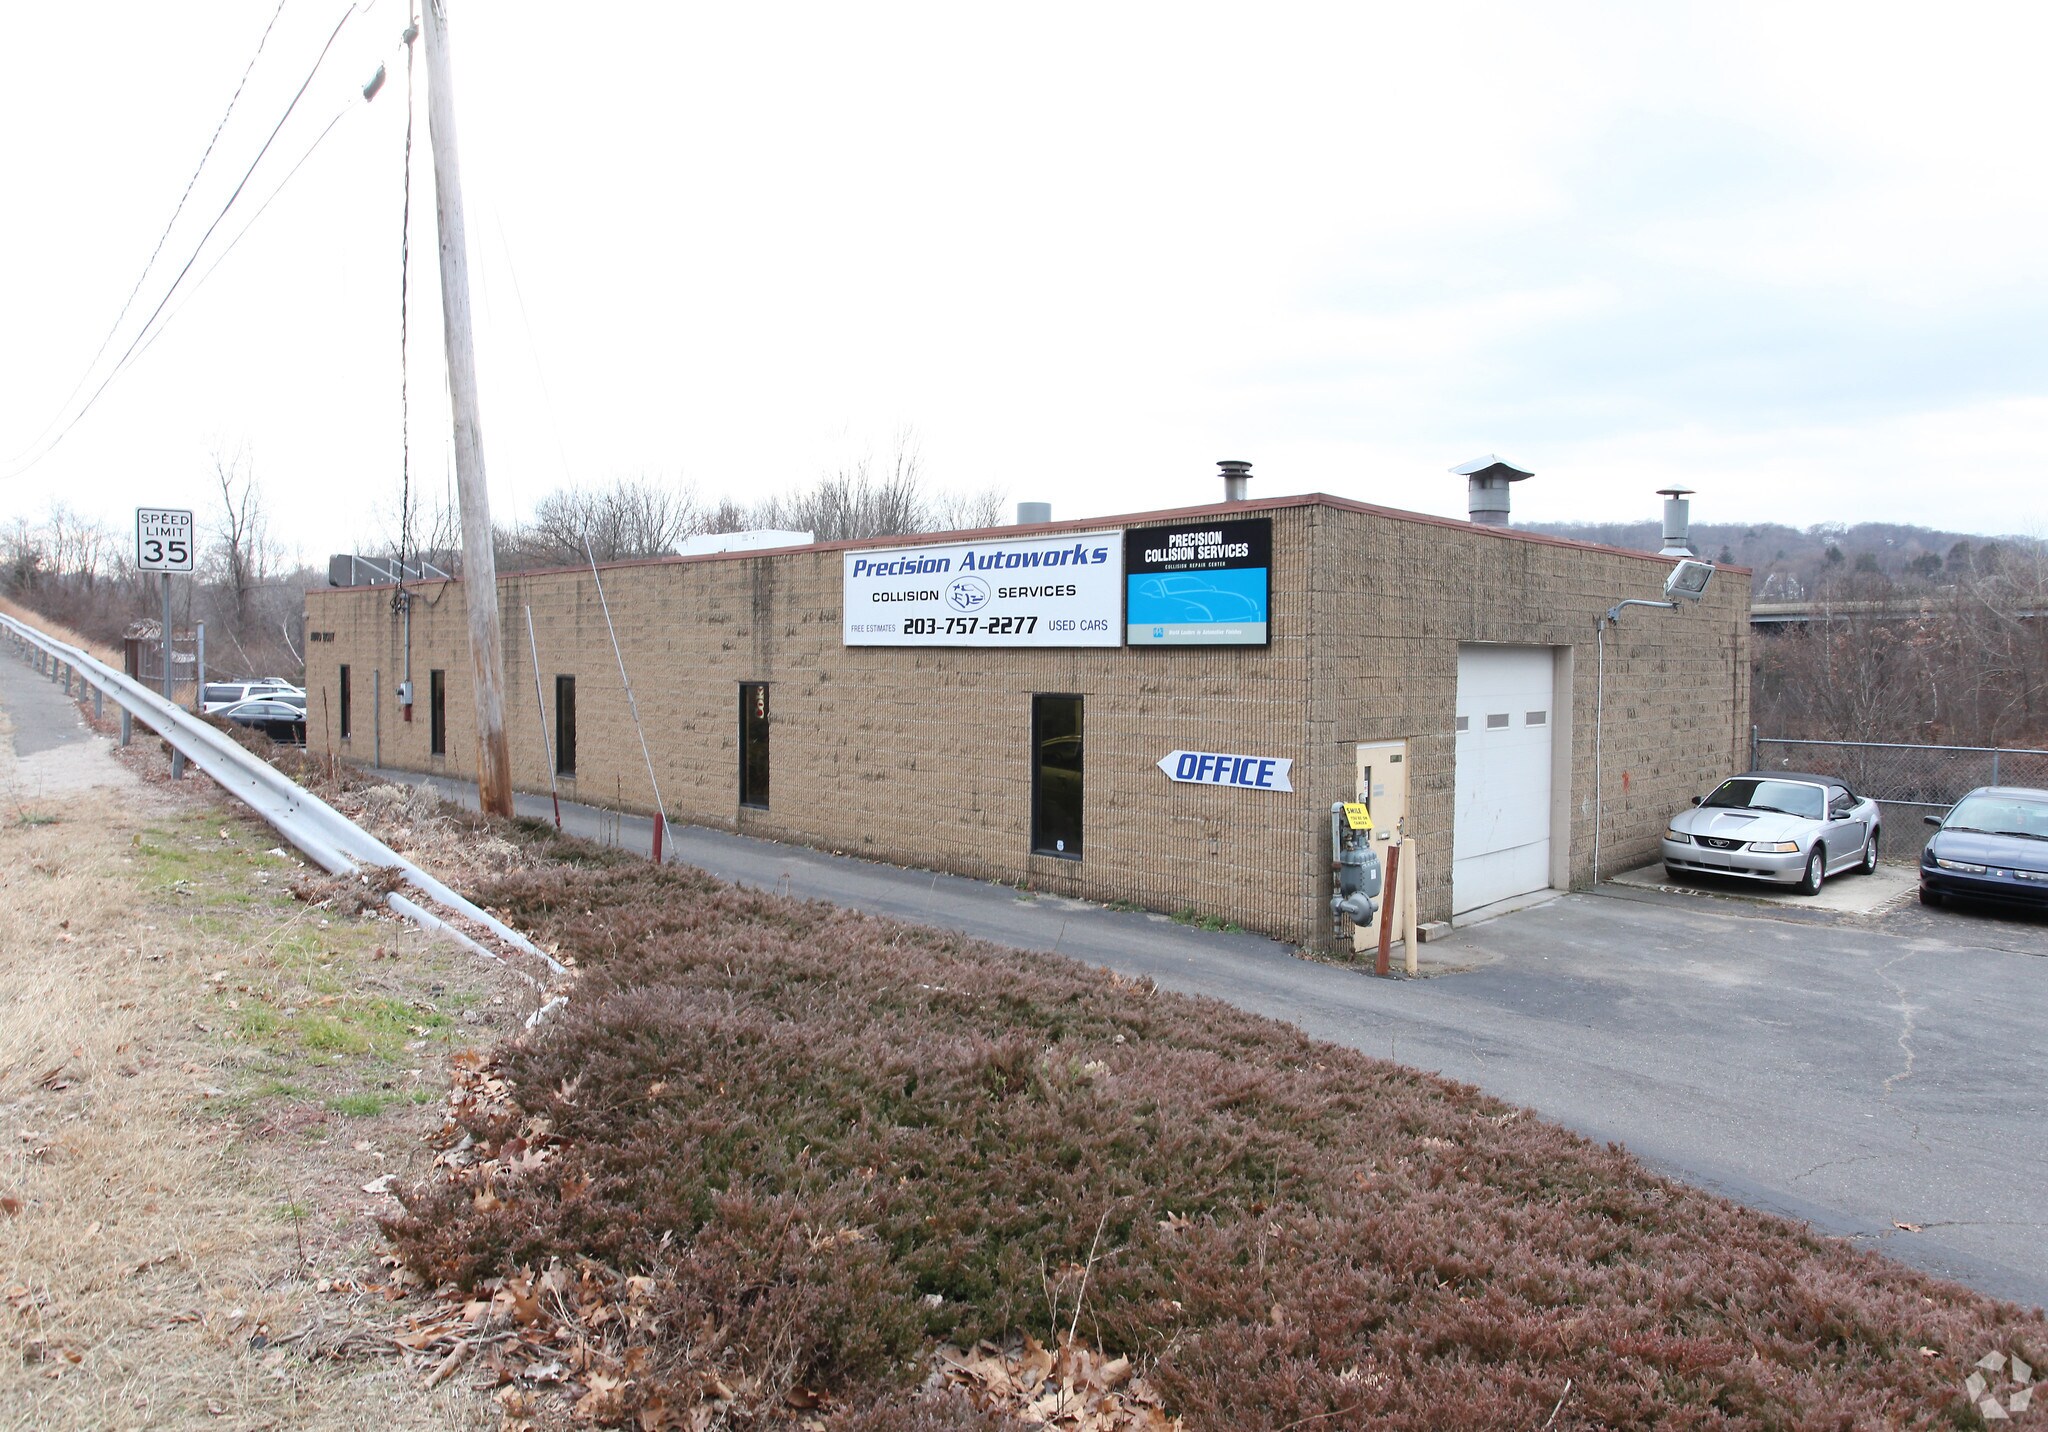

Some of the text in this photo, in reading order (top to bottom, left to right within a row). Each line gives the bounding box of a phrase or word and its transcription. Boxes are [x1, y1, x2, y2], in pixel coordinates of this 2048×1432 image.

[141, 513, 189, 525] SPEED
[147, 527, 184, 537] LIMIT
[1168, 530, 1222, 548] PRECISION
[144, 540, 188, 563] 35
[852, 543, 1109, 578] Precision Autoworks
[1145, 542, 1249, 562] COLLISION SERVICES
[872, 584, 1076, 602] COLLISION SERVICES
[851, 616, 1108, 635] FREE ESTIMATES 203-757-2277 USED CARS
[1176, 753, 1276, 788] OFFICE
